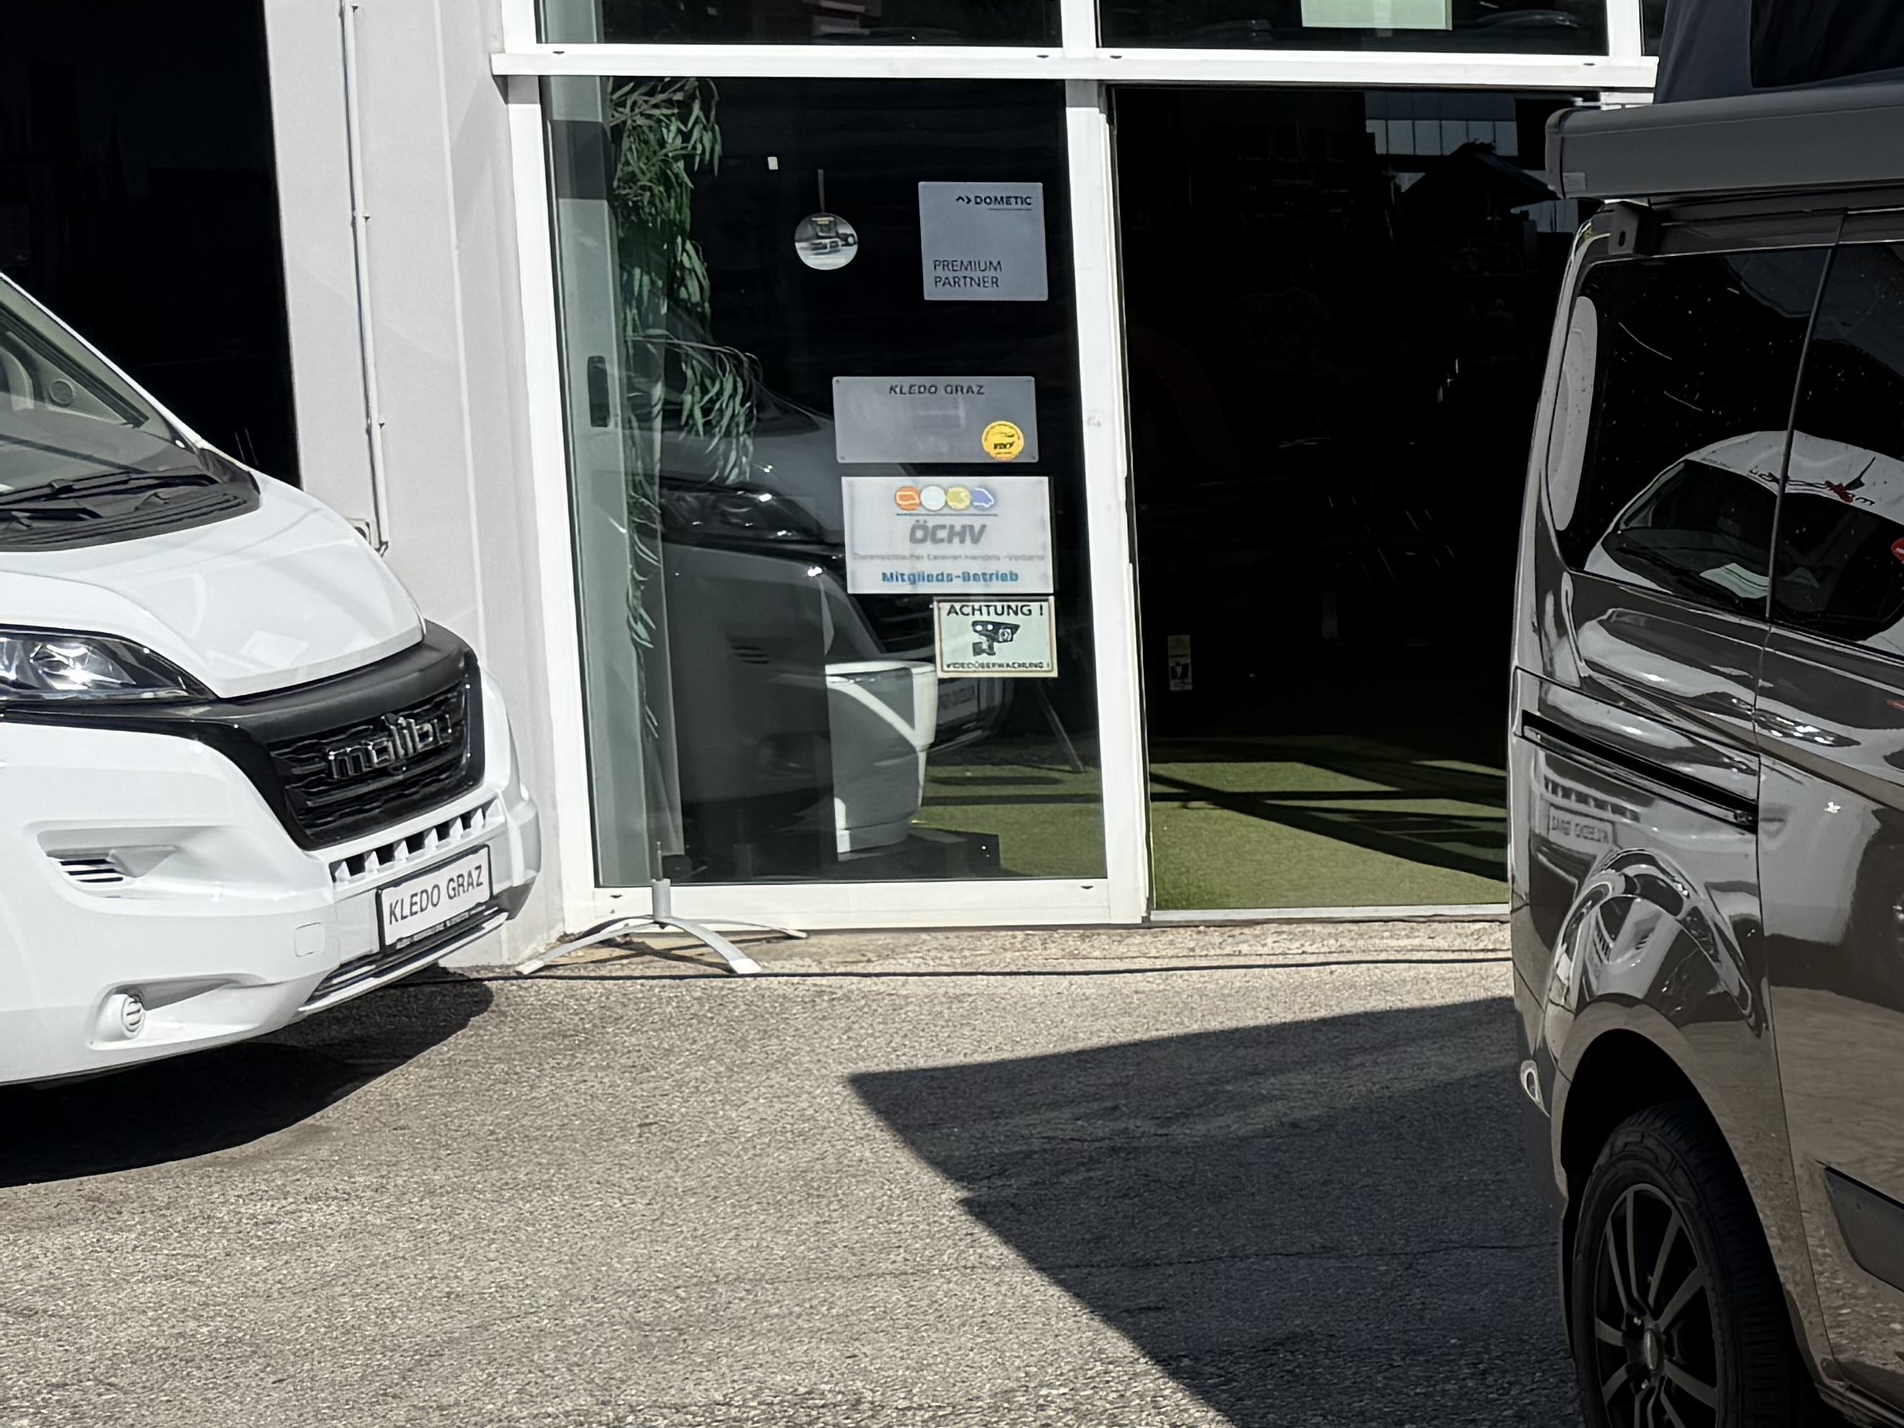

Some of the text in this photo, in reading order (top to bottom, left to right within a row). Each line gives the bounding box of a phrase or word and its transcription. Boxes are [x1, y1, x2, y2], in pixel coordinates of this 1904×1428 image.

[975, 195, 1033, 206] DOMETIC
[933, 260, 1002, 272] PREMIUM
[934, 275, 1000, 288] PARTNER
[889, 384, 985, 395] KLEDO GRAZ
[909, 519, 987, 544] ÖCHV
[947, 604, 1032, 617] ACHTUNG
[327, 714, 453, 779] malibu
[389, 864, 484, 926] KLEDO GRAZ
